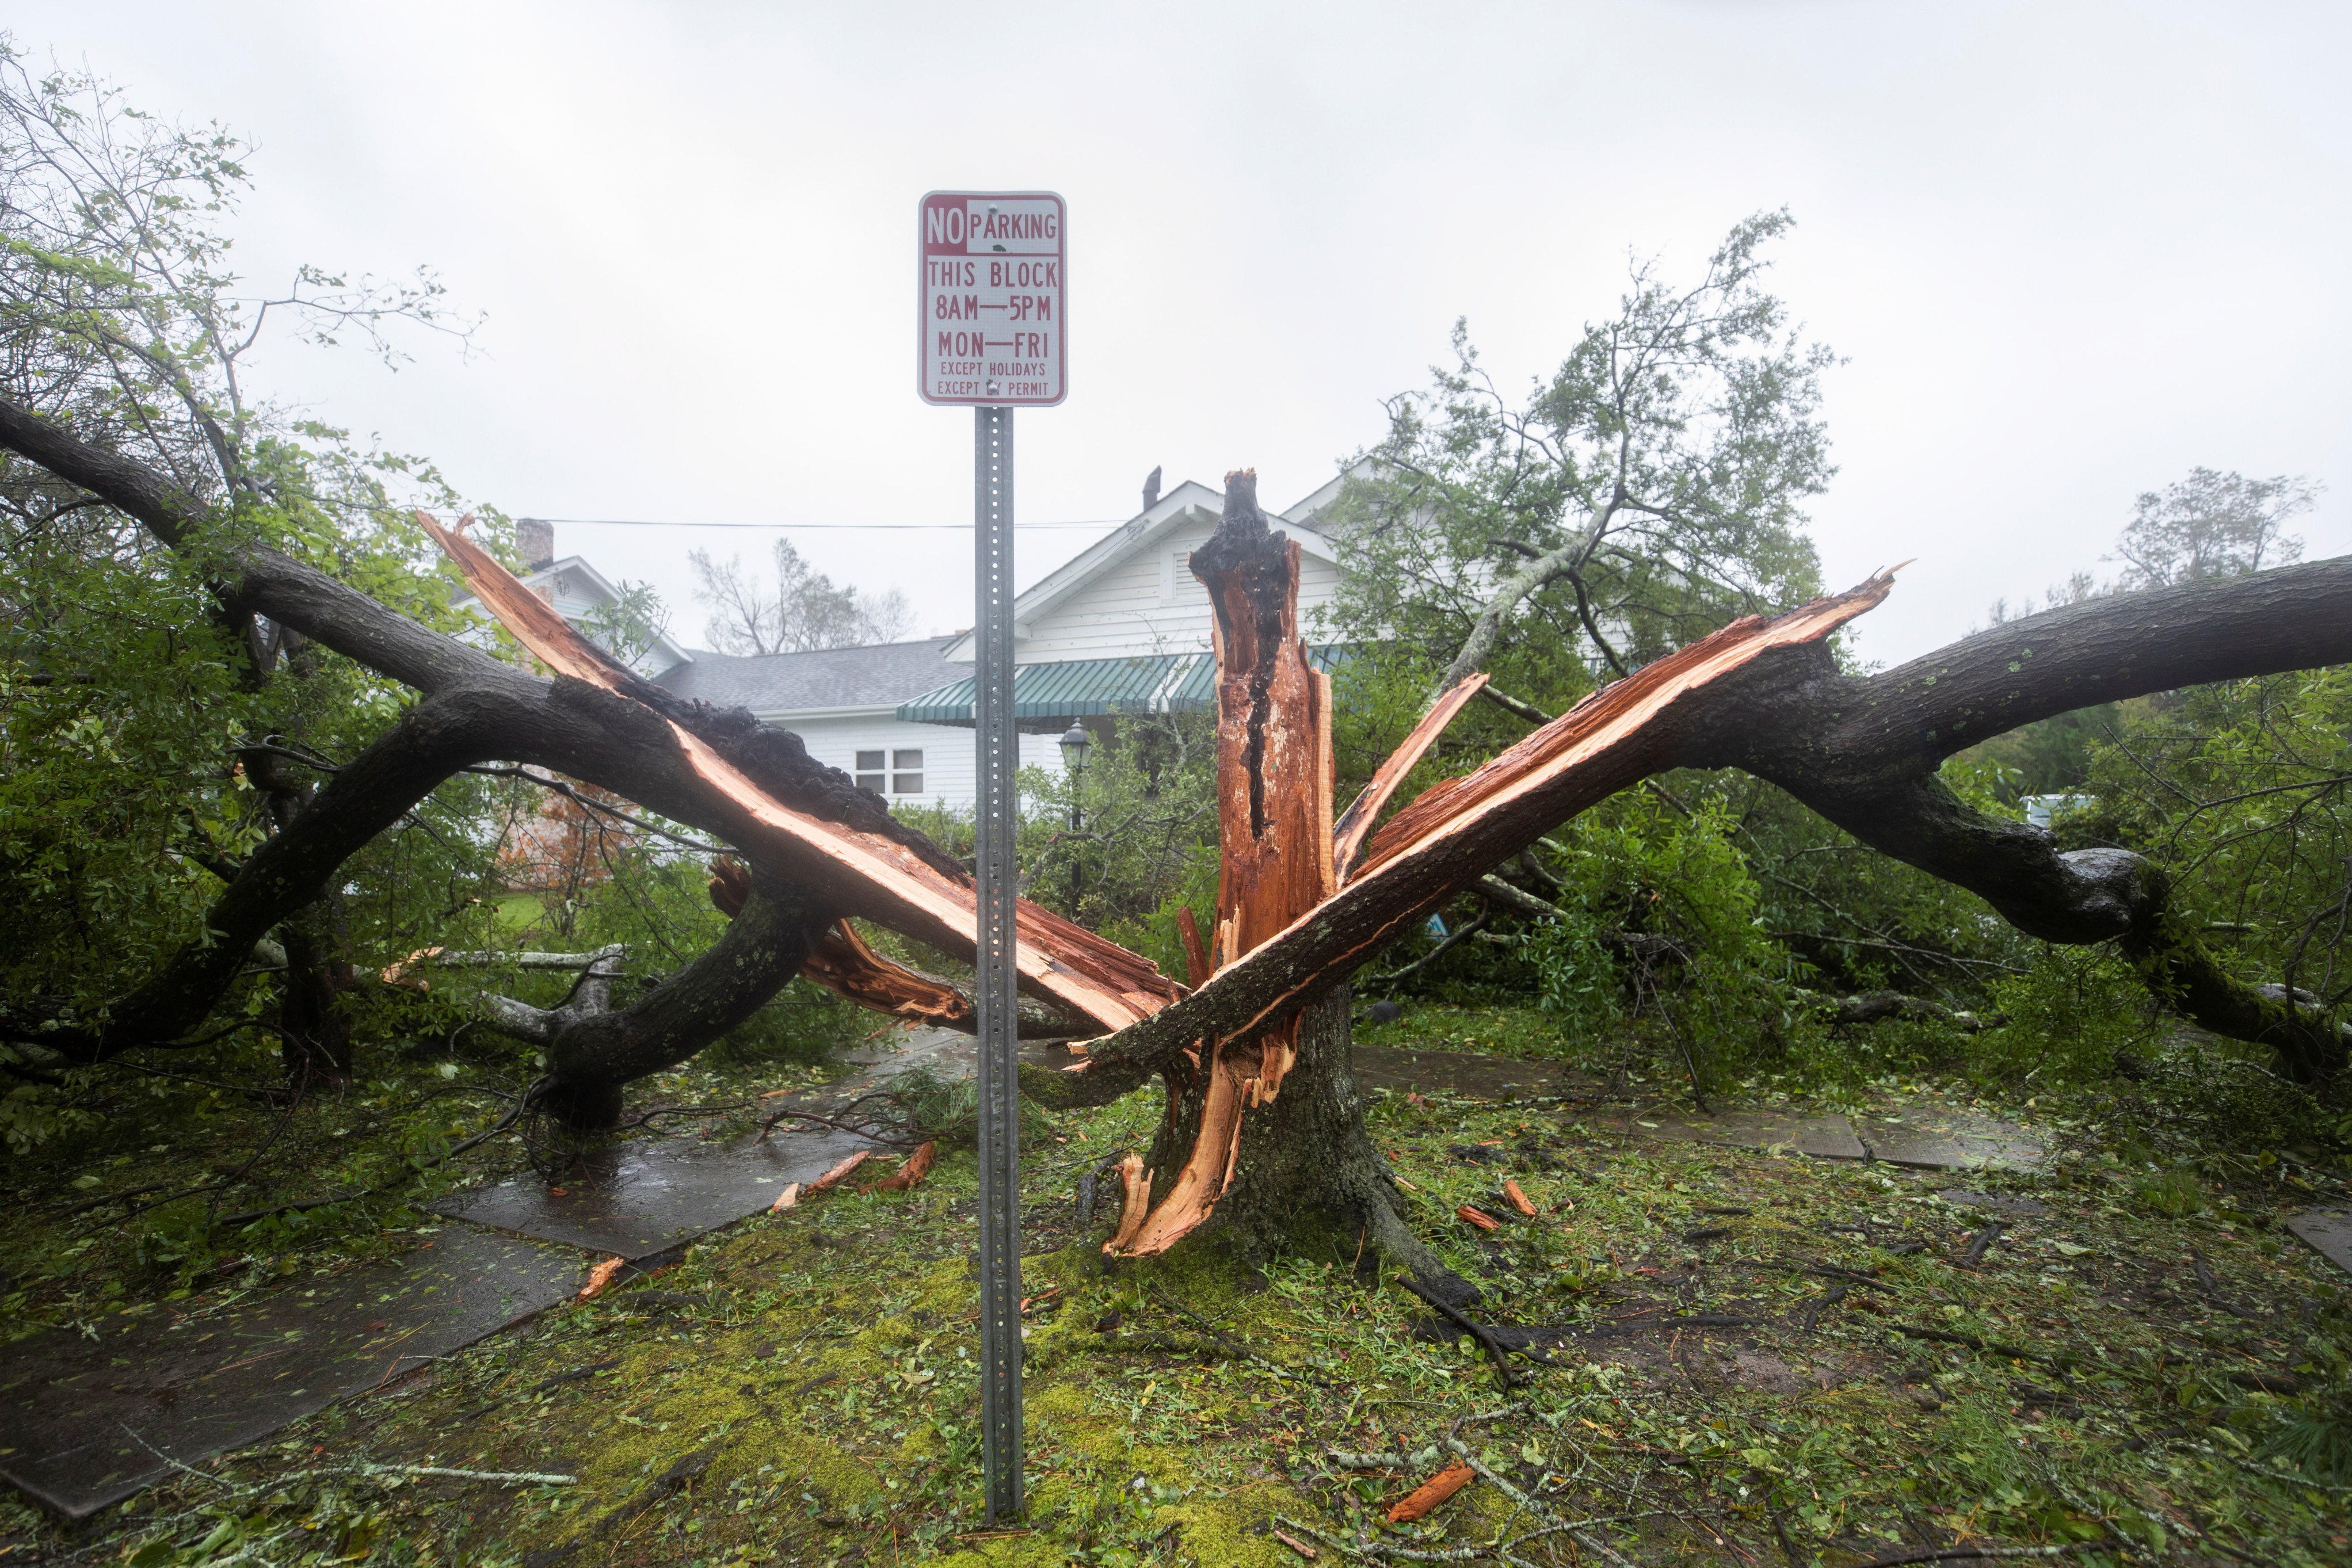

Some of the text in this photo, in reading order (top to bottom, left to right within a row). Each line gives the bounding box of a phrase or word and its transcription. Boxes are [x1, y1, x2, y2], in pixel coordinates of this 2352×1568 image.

[927, 207, 1057, 244] NO PARKING
[929, 261, 1057, 287] THIS BLOCK
[941, 362, 1045, 376] EXCEPT HOLIDAYS
[938, 381, 979, 395] EXCEPT
[1009, 382, 1048, 395] PERMIT
